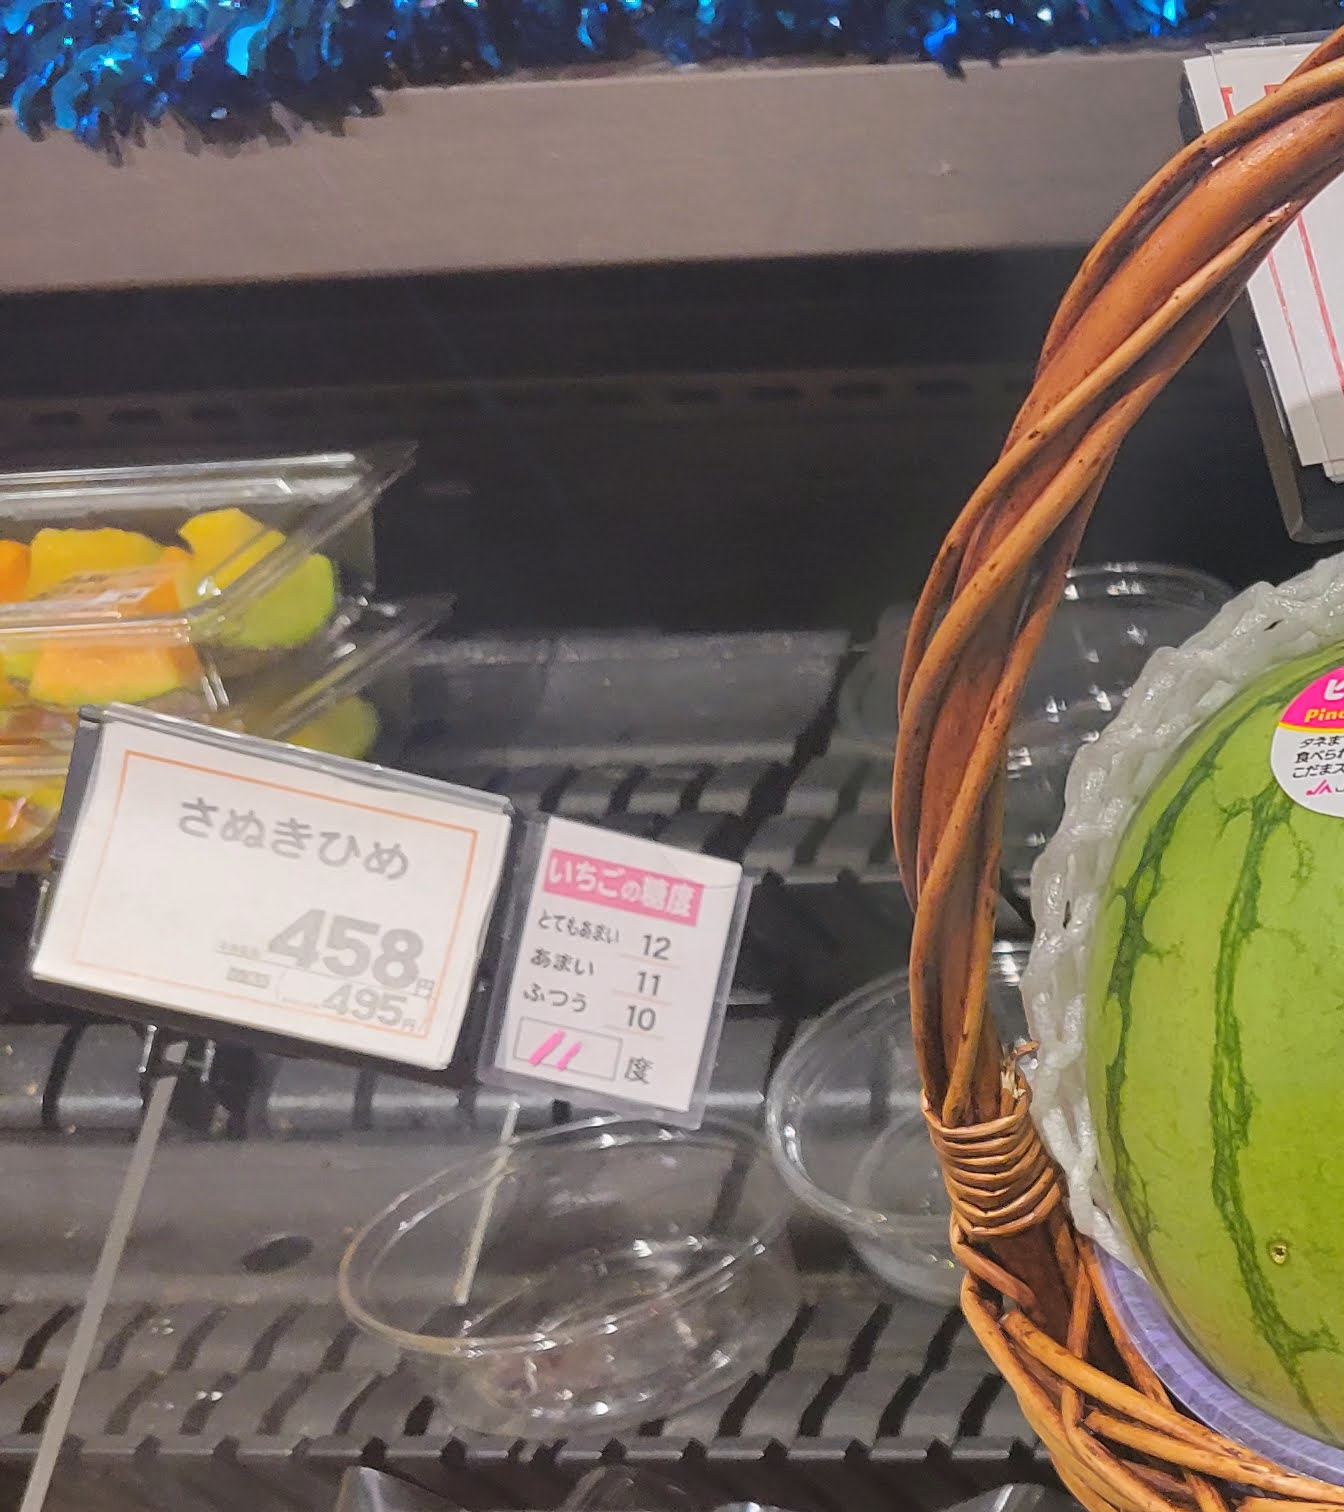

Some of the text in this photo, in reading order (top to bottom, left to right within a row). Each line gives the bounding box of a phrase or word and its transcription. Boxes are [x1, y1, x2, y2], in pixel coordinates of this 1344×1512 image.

[178, 797, 410, 882] さぬきひめ
[538, 909, 672, 961] とてもあまい 12
[530, 948, 661, 997] あまい 11
[523, 983, 657, 1031] ふつう 10
[624, 1056, 654, 1084] 度
